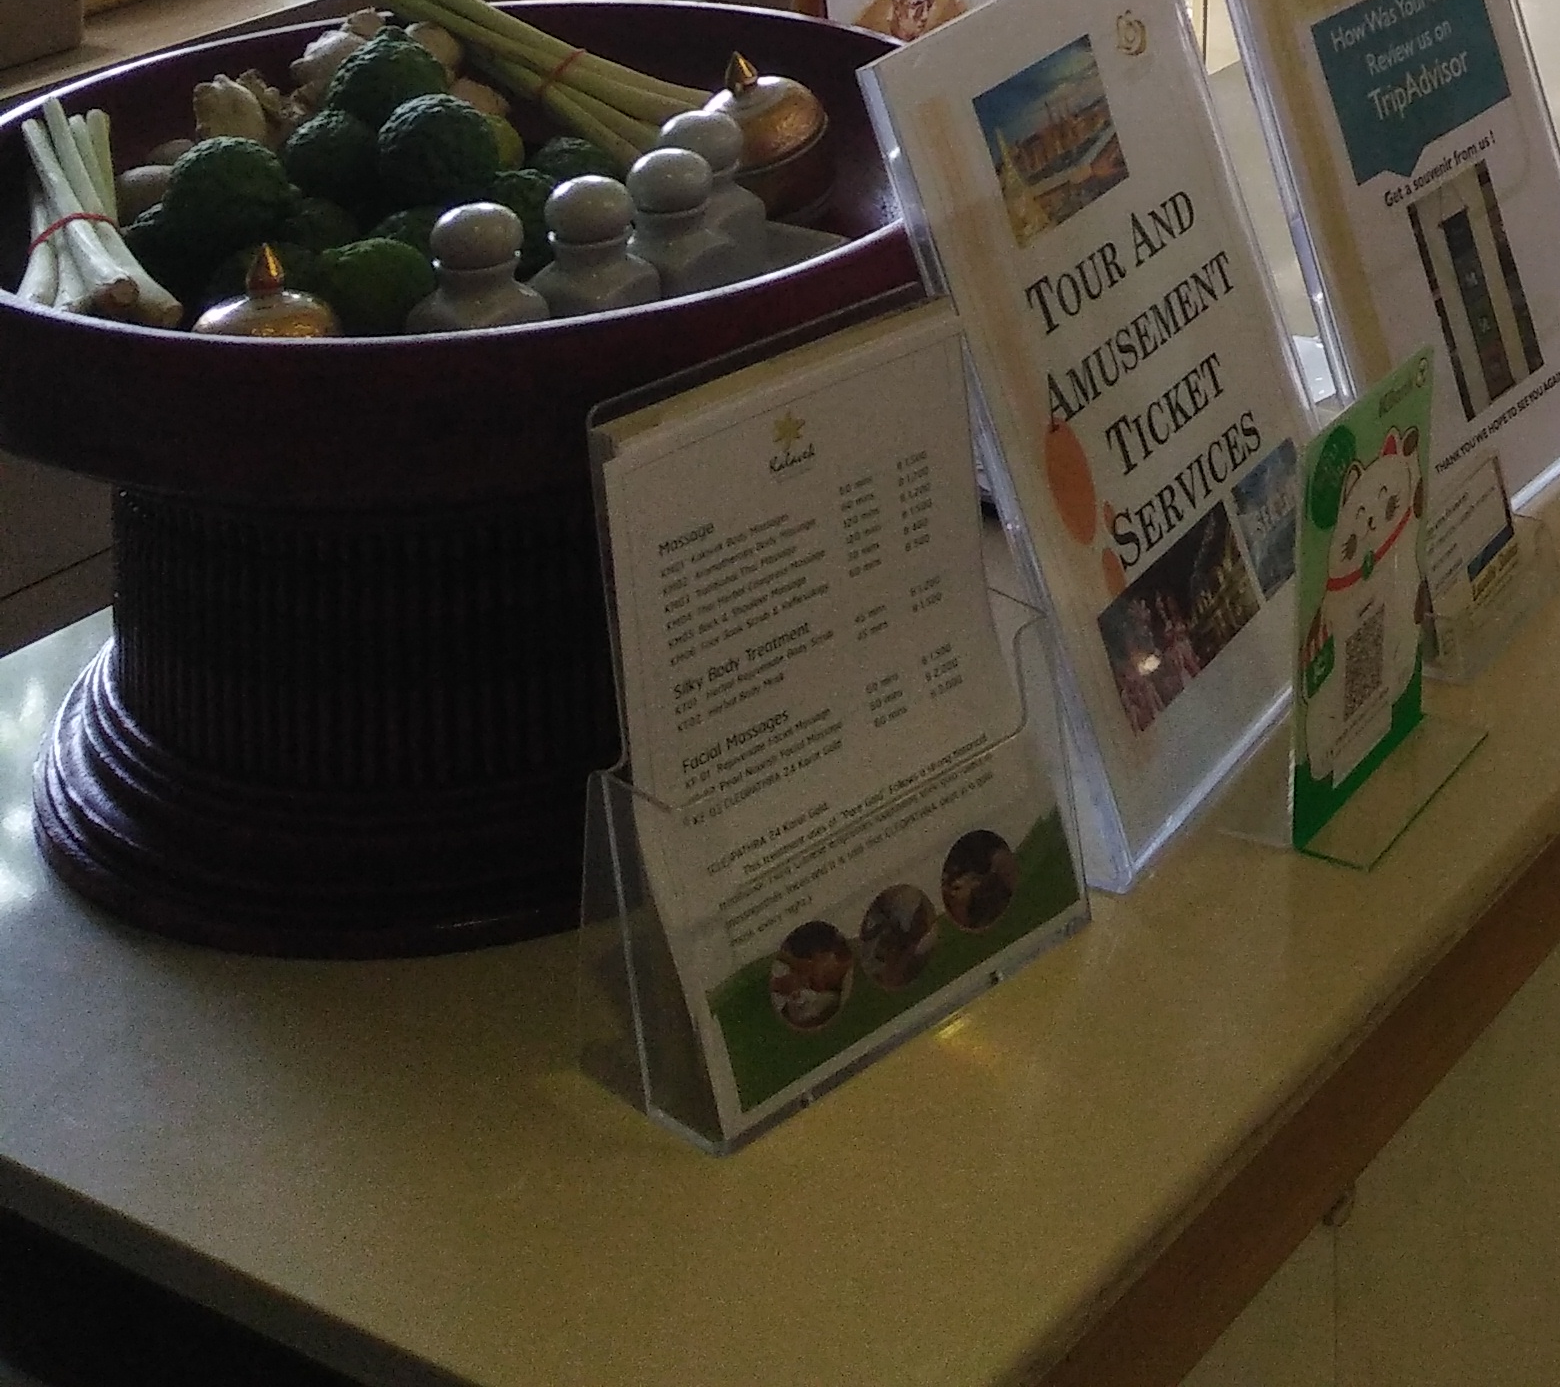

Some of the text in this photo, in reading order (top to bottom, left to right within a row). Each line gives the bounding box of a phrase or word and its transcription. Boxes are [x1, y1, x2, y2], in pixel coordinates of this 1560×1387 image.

[1331, 21, 1366, 52] How
[1365, 5, 1397, 31] Was
[1366, 20, 1452, 76] Review us on
[1367, 50, 1468, 121] TripAdvisor
[1384, 186, 1404, 207] Get
[1413, 156, 1453, 190] souvenir
[1453, 144, 1478, 166] from
[1434, 450, 1462, 474] THANK
[1460, 438, 1477, 456] YOU
[1474, 428, 1489, 444] WE
[1487, 413, 1509, 434] HOPE
[1516, 397, 1530, 412] SEE
[1528, 385, 1544, 402] YOU
[657, 522, 715, 557] Massage
[673, 620, 810, 700] Silky Body Treatment
[681, 707, 790, 774] Facial Massages
